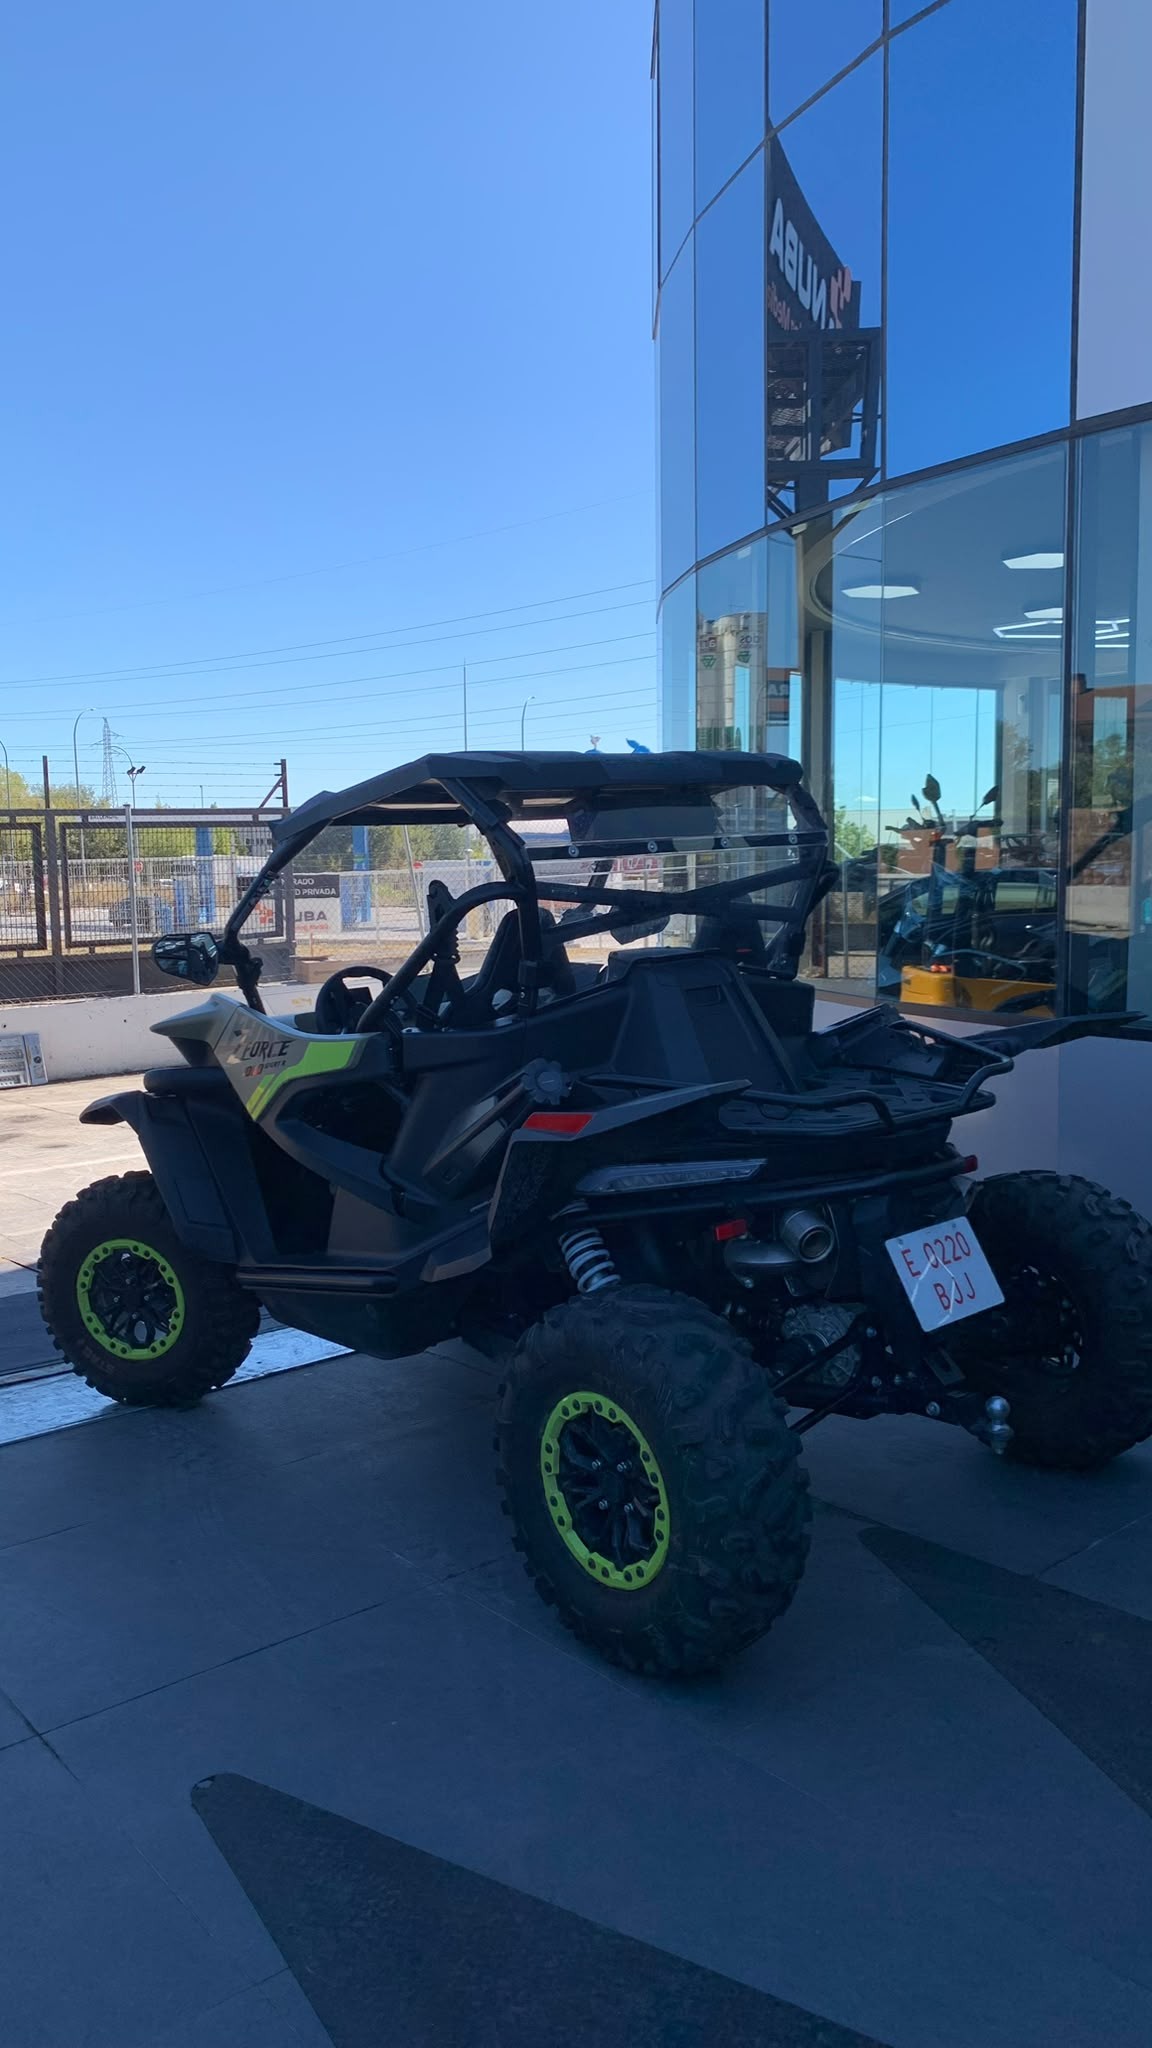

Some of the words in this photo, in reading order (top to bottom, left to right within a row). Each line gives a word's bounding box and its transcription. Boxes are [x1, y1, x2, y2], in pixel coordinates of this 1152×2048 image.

[293, 878, 315, 886] RADO
[302, 887, 337, 896] PRIVADA
[294, 911, 328, 922] UBA
[901, 1248, 922, 1277] E
[923, 1231, 971, 1269] 0220
[933, 1272, 976, 1311] BJJ
